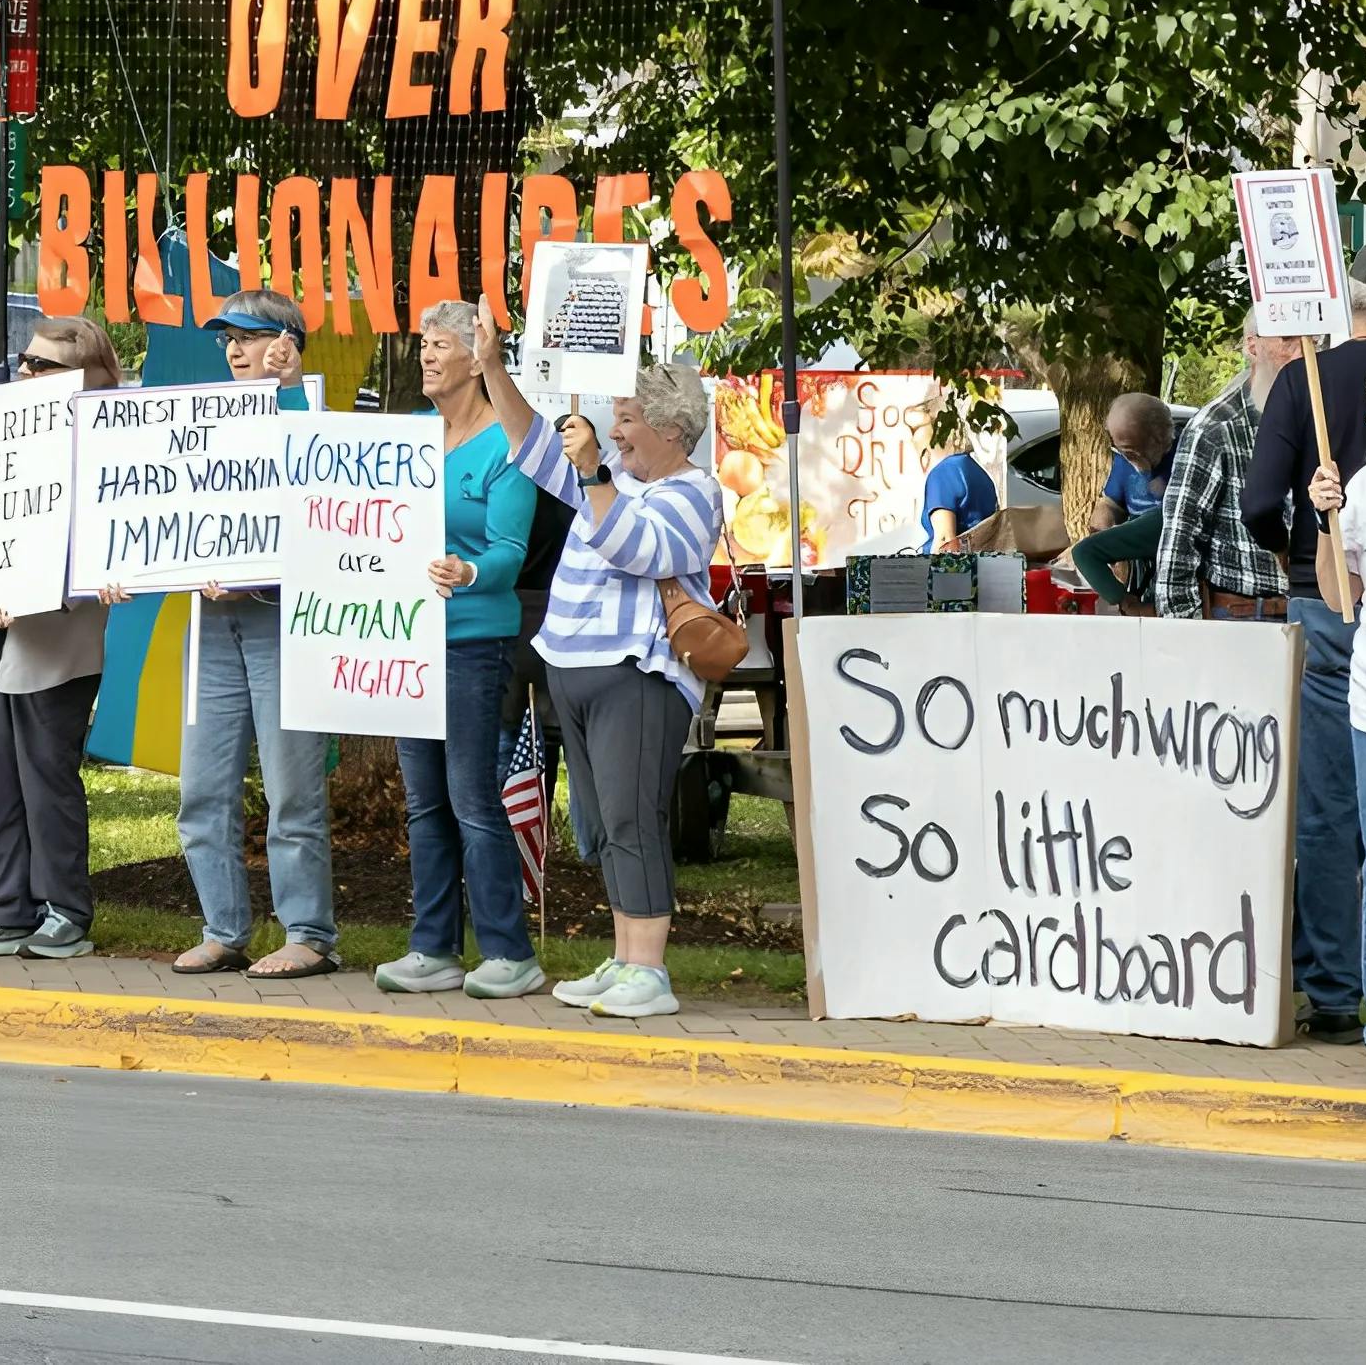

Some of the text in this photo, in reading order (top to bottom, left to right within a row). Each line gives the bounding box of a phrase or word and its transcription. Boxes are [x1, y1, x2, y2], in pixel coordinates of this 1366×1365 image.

[92, 398, 181, 429] ARREST
[167, 425, 218, 455] NOT
[285, 433, 437, 491] WORKERS
[97, 464, 178, 503] HARD
[304, 494, 411, 543] RIGHTS
[338, 551, 386, 573] are
[330, 654, 430, 699] RIGHTS
[997, 671, 1140, 759] much
[1145, 697, 1281, 819] wrong
[995, 789, 1133, 897] little
[933, 890, 1257, 1015] cardboard
